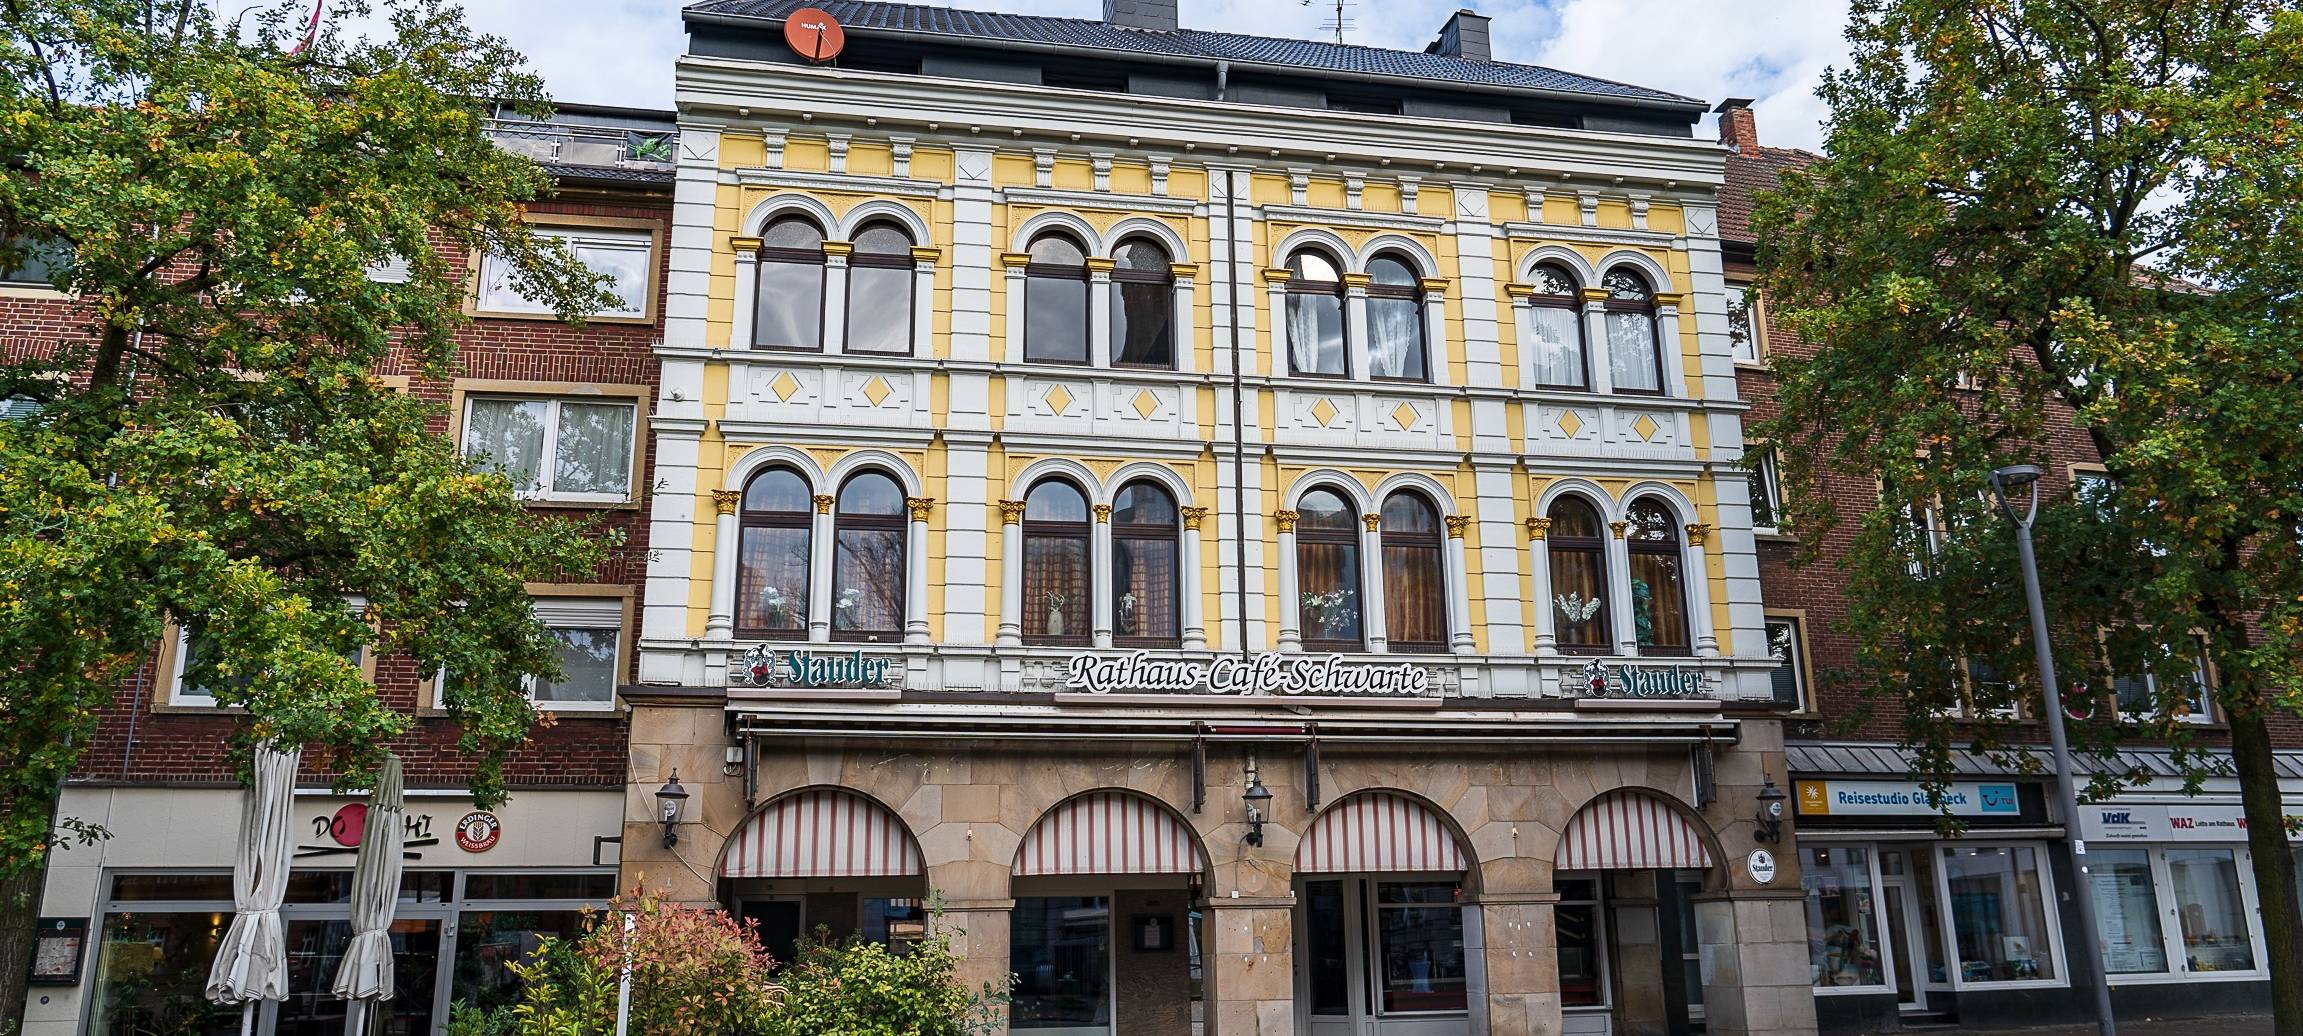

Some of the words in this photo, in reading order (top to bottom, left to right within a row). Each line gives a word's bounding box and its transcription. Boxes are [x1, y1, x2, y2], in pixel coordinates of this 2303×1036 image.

[801, 22, 827, 31] HUMX
[1066, 650, 1428, 694] Rathaus-Café-Schwarte
[1838, 791, 1909, 805] Reisestudio
[459, 814, 498, 830] ERDINGER
[2101, 812, 2131, 824] VdK
[2170, 817, 2194, 829] WAZ
[1752, 864, 1773, 873] Stauder
